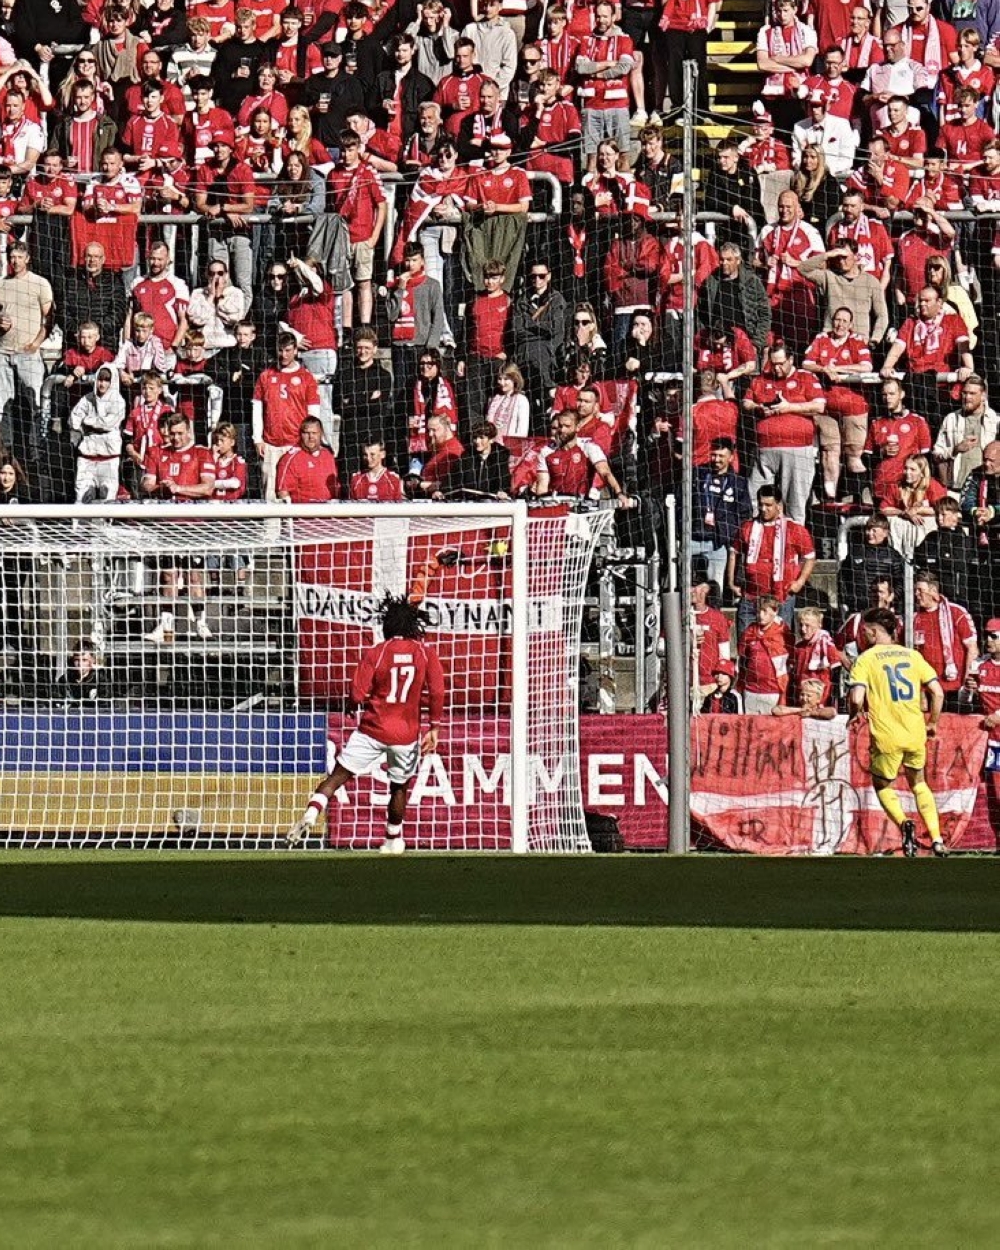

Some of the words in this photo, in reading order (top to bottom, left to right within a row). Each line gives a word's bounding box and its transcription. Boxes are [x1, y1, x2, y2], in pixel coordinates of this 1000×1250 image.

[304, 587, 385, 626] DANS
[386, 665, 415, 703] 17
[882, 662, 914, 702] 15
